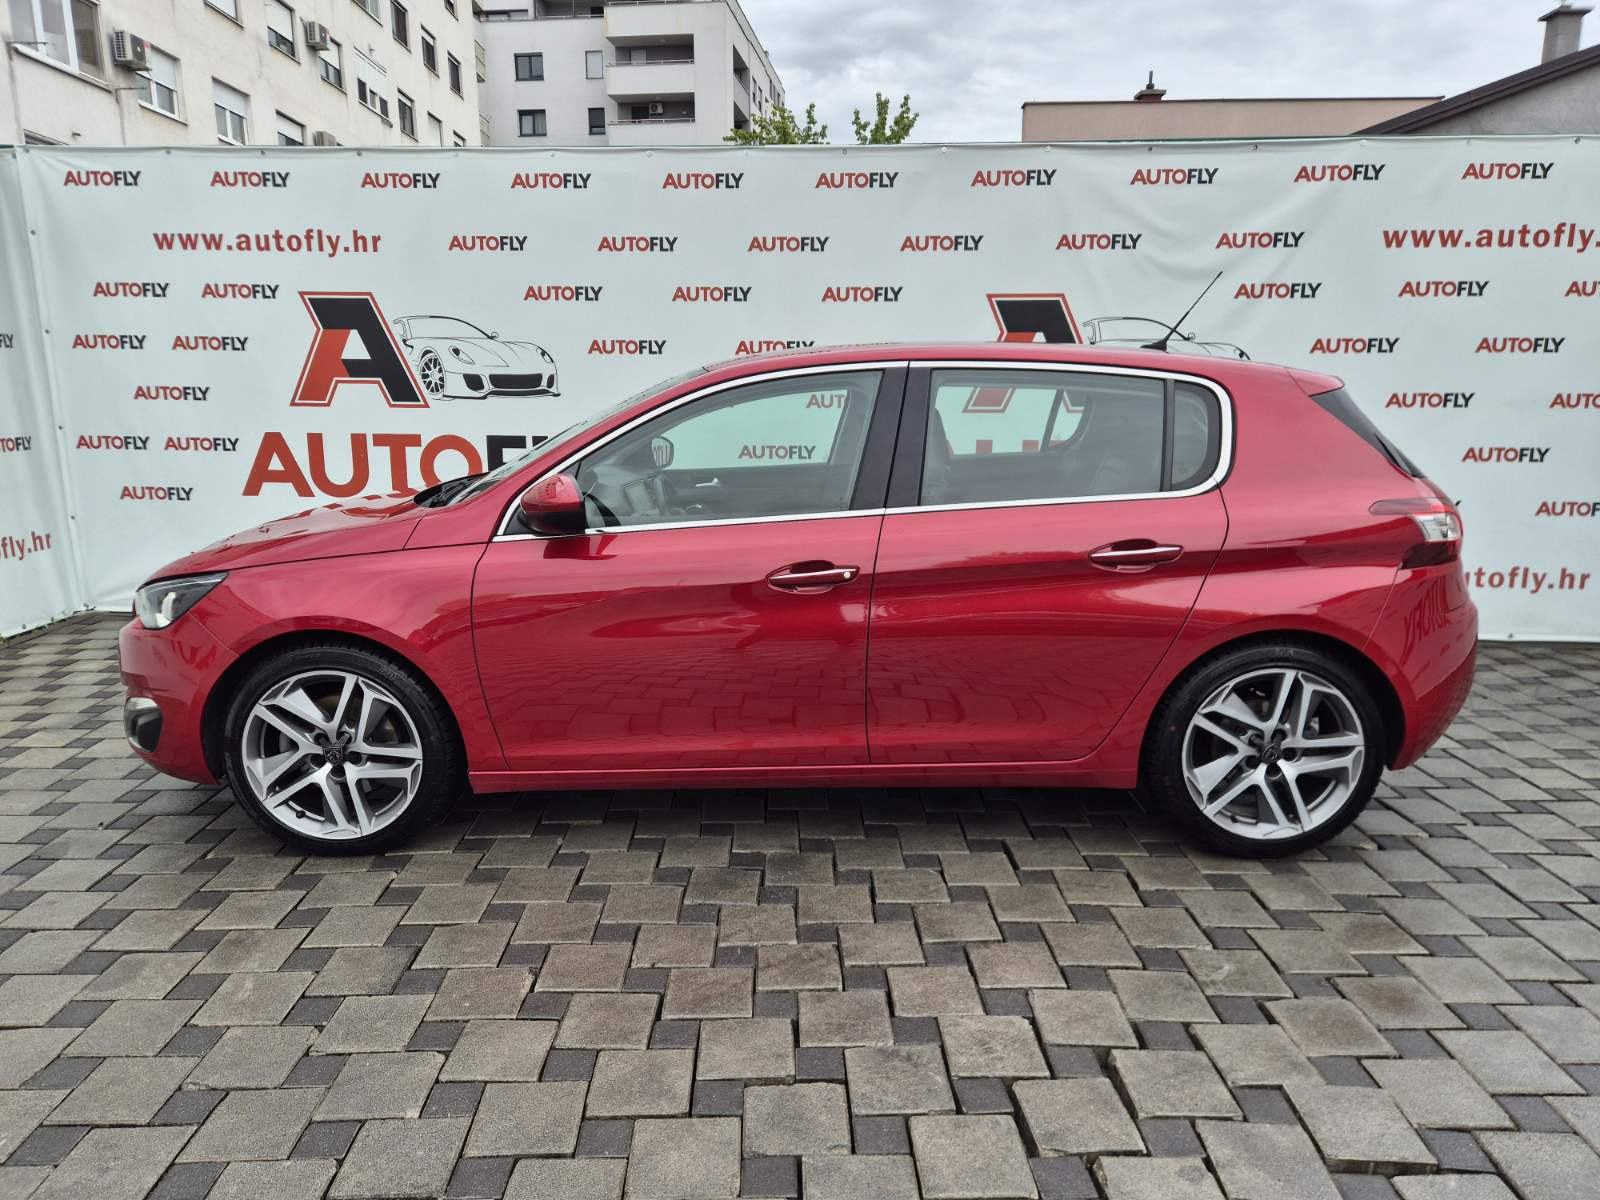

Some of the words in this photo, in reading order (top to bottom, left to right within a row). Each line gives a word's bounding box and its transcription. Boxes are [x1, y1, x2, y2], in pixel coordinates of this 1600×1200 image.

[63, 170, 142, 187] AUTOFLY
[210, 170, 291, 188] AUTOFLY
[970, 167, 1057, 187] AUTOFLY
[1129, 167, 1220, 186] AUTOFLY
[1293, 163, 1386, 183] AUTOFLY
[1461, 162, 1555, 180] AUTOFLY
[360, 172, 441, 189] AUTOFLY
[510, 172, 592, 190] AUTOFLY
[662, 172, 745, 190] AUTOFLY
[814, 171, 900, 189] AUTOFLY
[152, 228, 382, 258] www.autofly.hr
[448, 235, 528, 252] AUTOFLY
[597, 236, 679, 253] AUTOFLY
[747, 235, 830, 253] AUTOFLY
[899, 234, 984, 252] AUTOFLY
[1055, 233, 1143, 251] AUTOFLY
[1215, 231, 1306, 250] AUTOFLY
[92, 281, 170, 298] AUTOFLY
[201, 282, 280, 300] AUTOFLY
[523, 285, 604, 302] AUTOFLY
[671, 286, 753, 303] AUTOFLY
[821, 286, 904, 303] AUTOFLY
[1233, 282, 1323, 300] AUTOFLY
[1397, 280, 1490, 298] AUTOFLY
[71, 334, 147, 350] AUTOFLY
[171, 335, 249, 352] AUTOFLY
[587, 339, 667, 356] AUTOFLY
[1309, 337, 1401, 354] AUTOFLY
[1474, 336, 1566, 354] AUTOFLY
[133, 385, 211, 402] AUTOFLY
[1384, 392, 1475, 409] AUTOFLY
[75, 434, 150, 451] AUTOFLY
[163, 436, 240, 452] AUTOFLY
[738, 445, 816, 460] AUTOFLY
[1461, 446, 1551, 463] AUTOFLY
[242, 431, 549, 498] AUTOF
[119, 485, 194, 502] AUTOFLY
[0, 531, 52, 561] fly.hr
